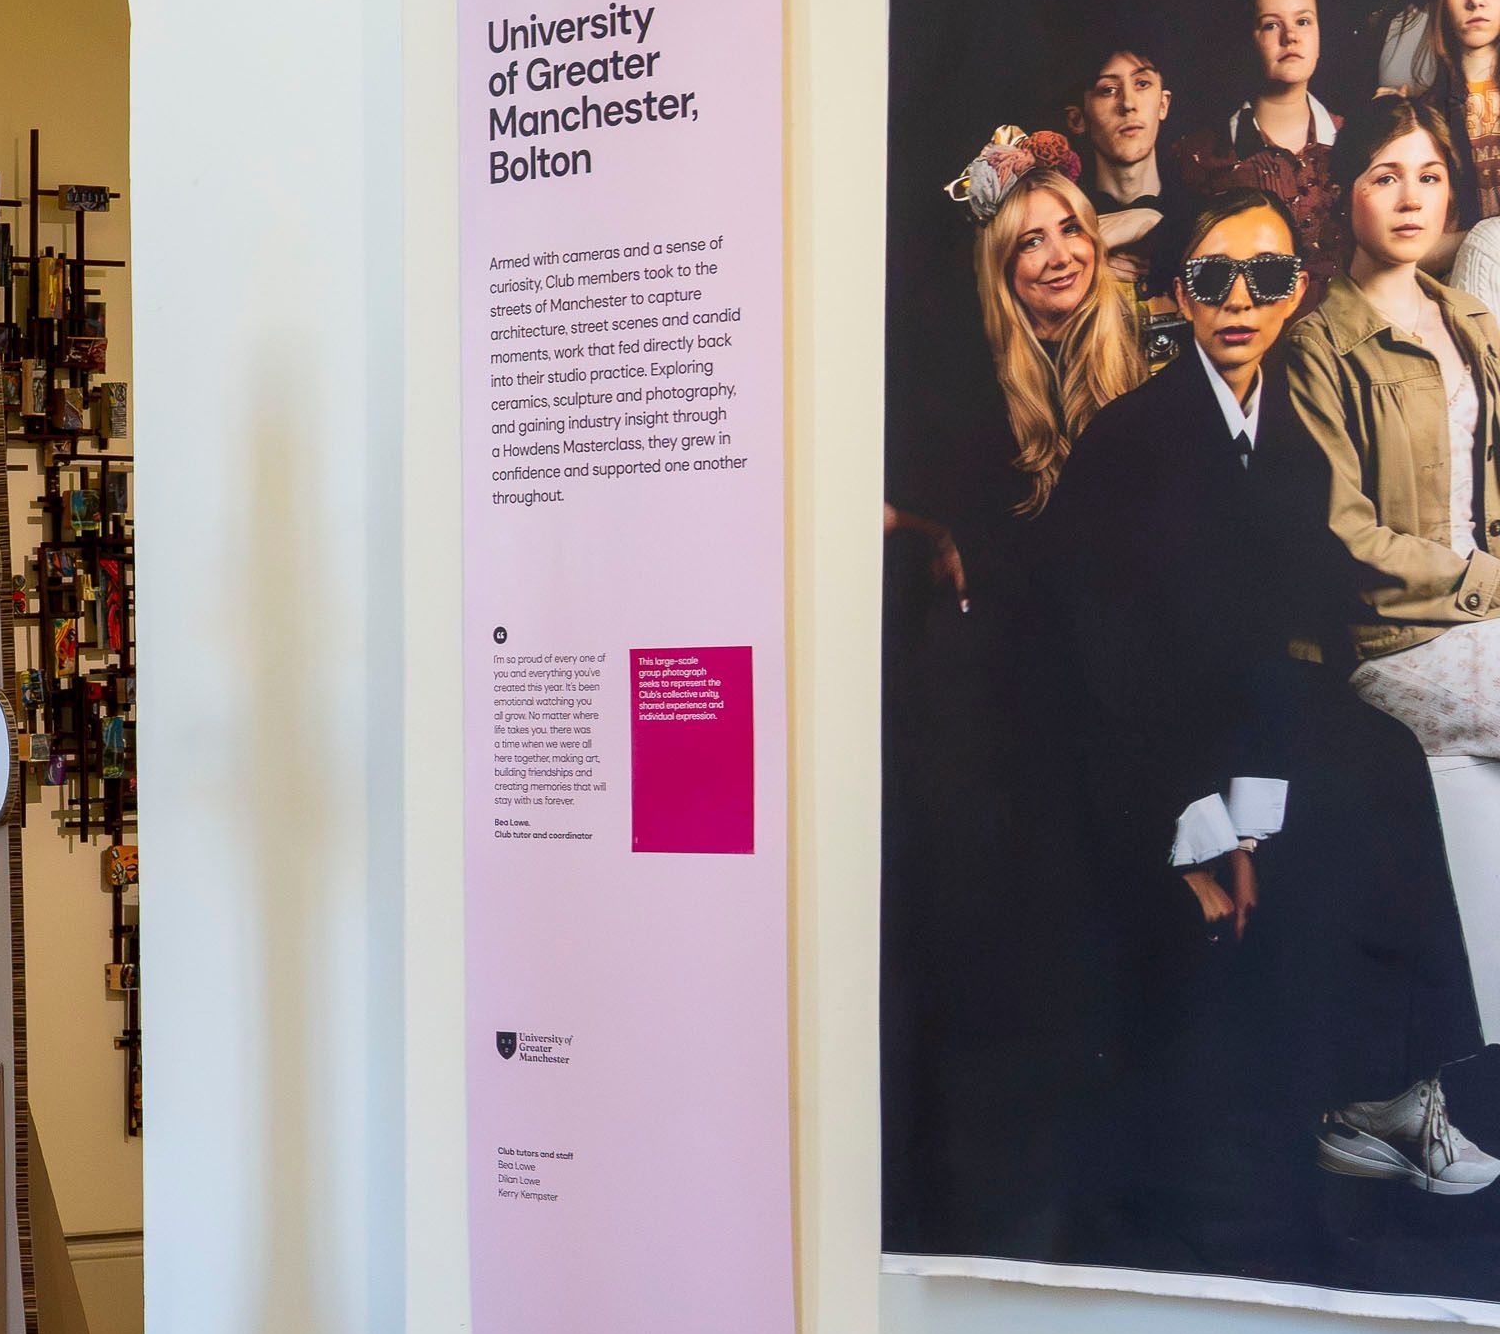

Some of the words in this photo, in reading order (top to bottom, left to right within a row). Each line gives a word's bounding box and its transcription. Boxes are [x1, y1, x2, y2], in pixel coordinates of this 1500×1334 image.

[488, 2, 655, 54] University
[488, 60, 519, 97] of
[526, 50, 661, 92] Greater
[489, 91, 698, 141] Manchester,
[490, 145, 592, 184] Bolton
[489, 253, 530, 271] Armed
[533, 251, 559, 266] with
[562, 248, 620, 264] cameras
[623, 241, 650, 258] and
[653, 244, 663, 255] a
[666, 240, 706, 254] sense
[709, 235, 724, 250] of
[489, 277, 543, 294] curiosity,
[545, 273, 575, 289] Club
[577, 269, 641, 286] members
[643, 264, 674, 280] took
[676, 265, 692, 277] to
[694, 261, 718, 276] the
